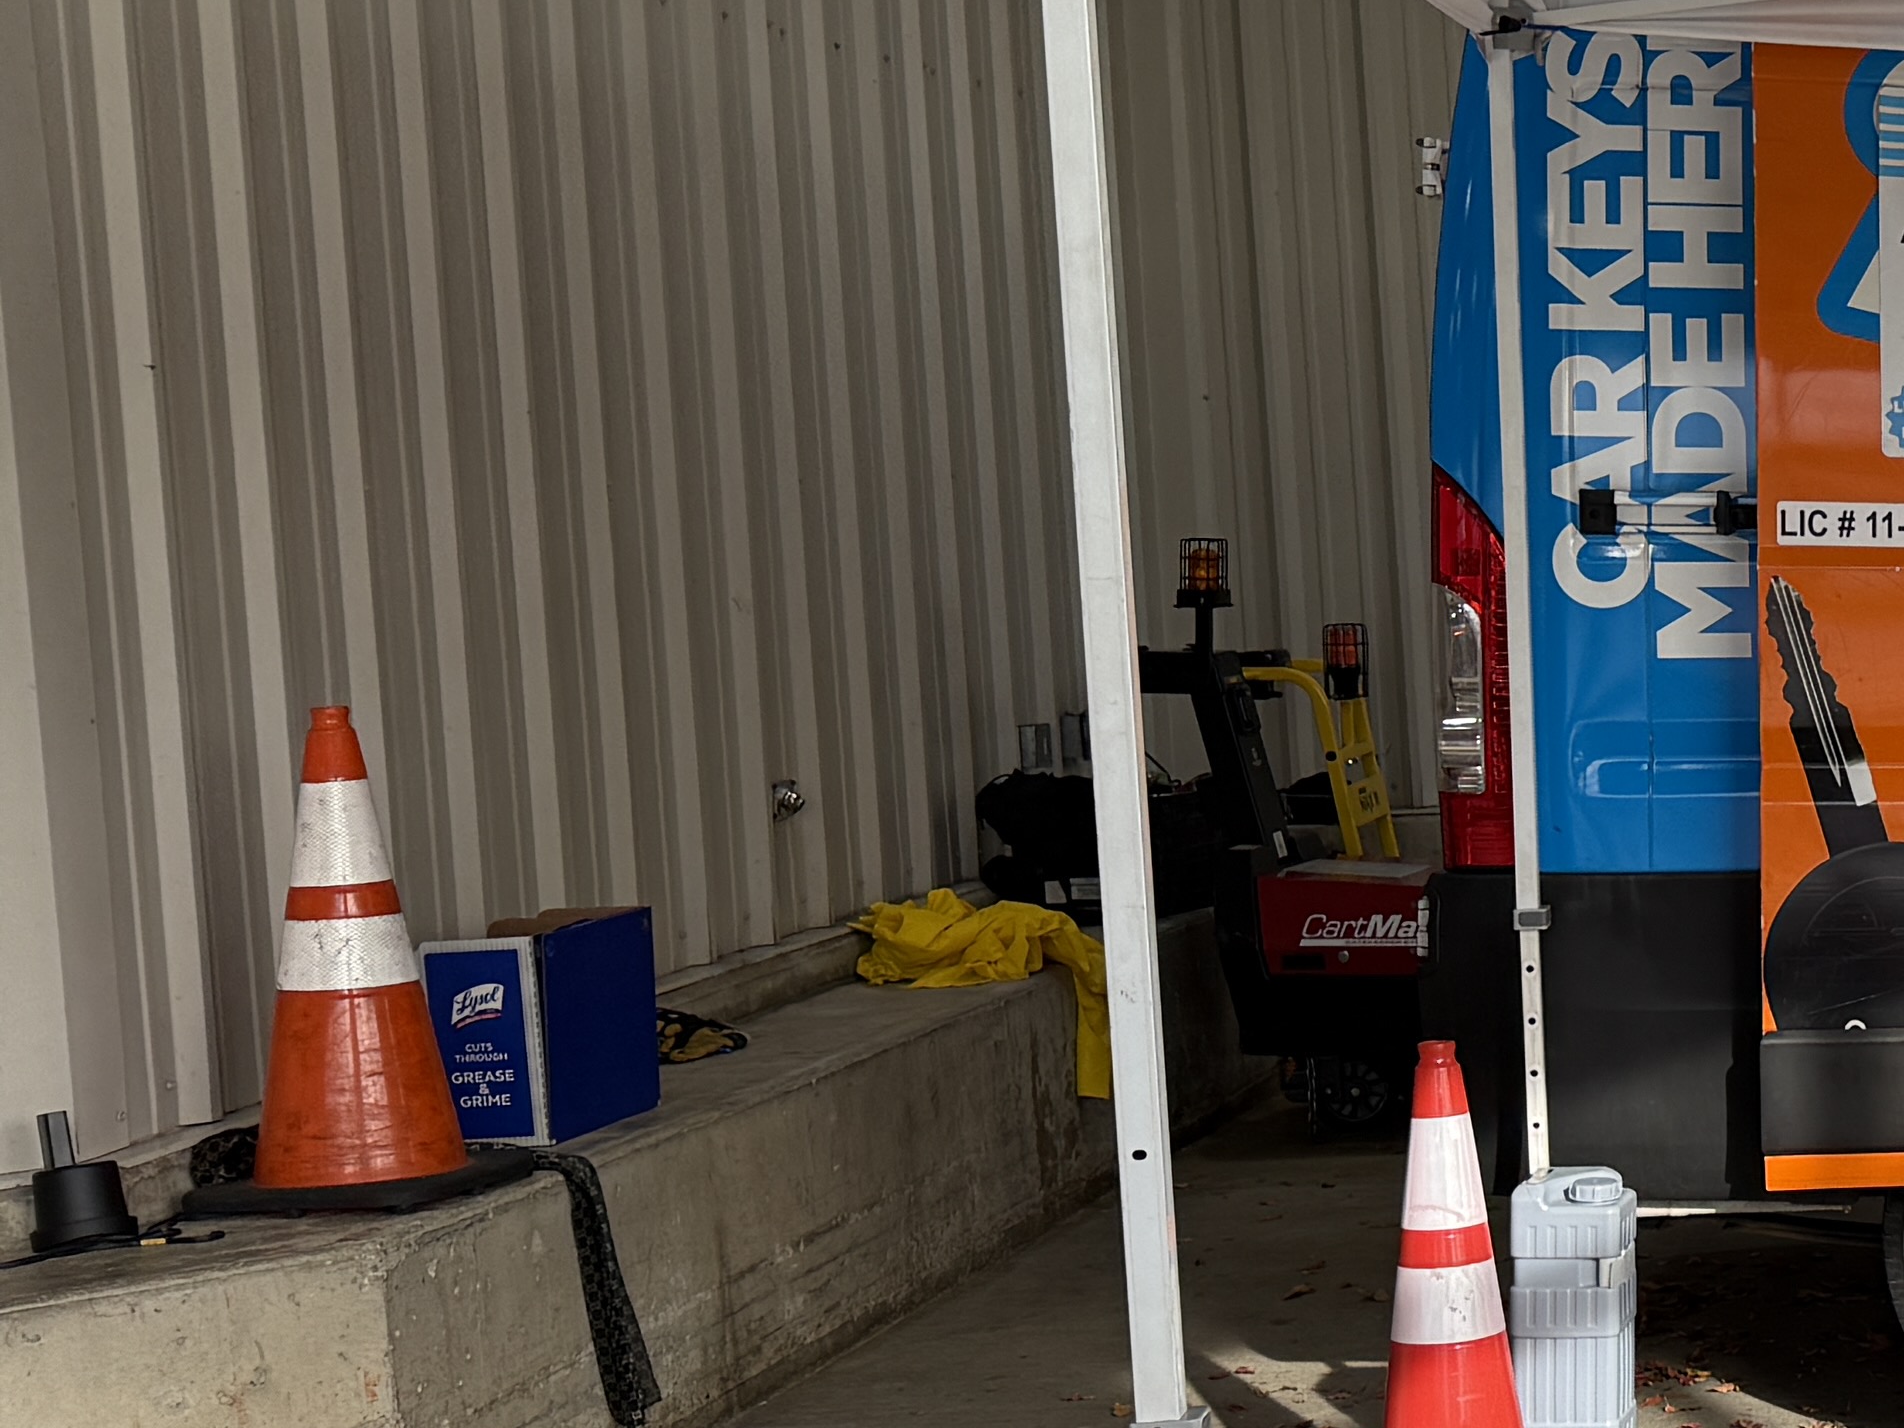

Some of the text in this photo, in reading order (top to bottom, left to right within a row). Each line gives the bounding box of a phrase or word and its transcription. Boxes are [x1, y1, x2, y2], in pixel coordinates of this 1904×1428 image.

[1545, 32, 1651, 609] CAR KEYS
[1646, 38, 1753, 659] MADE HER
[1780, 509, 1828, 537] LIC
[1838, 510, 1855, 538] #
[1302, 914, 1417, 938] CartMa
[455, 986, 500, 1015] Lysol
[465, 1043, 493, 1052] CUTS
[451, 1070, 515, 1084] GREASE
[460, 1094, 512, 1108] GRIME
